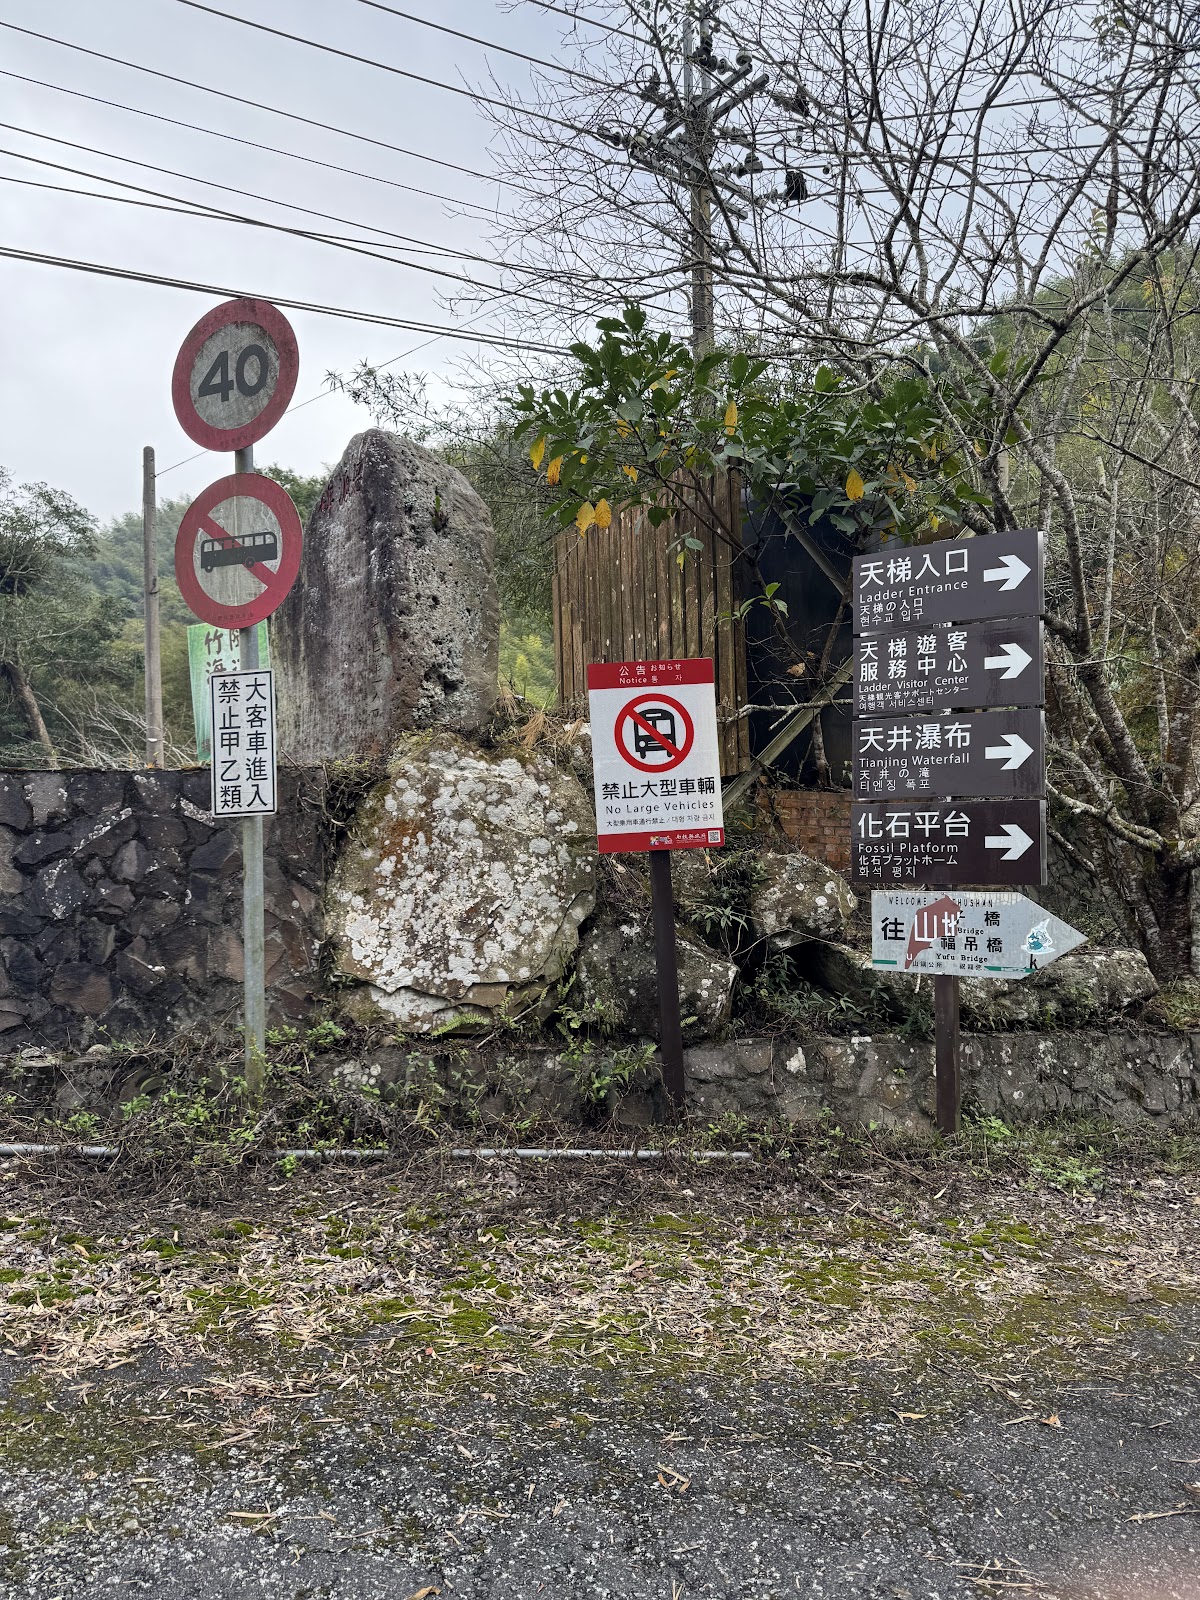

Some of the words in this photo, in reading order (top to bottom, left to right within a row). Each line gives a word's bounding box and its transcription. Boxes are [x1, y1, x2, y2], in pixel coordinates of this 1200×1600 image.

[198, 344, 269, 402] 40
[859, 548, 968, 589] 天梯入口
[859, 589, 903, 604] Ladder
[909, 580, 968, 596] Entrance
[860, 598, 923, 616] 天梯の入口
[860, 613, 894, 627] 현수교
[901, 609, 923, 622] 입구
[859, 631, 968, 661] 天梯遊客
[619, 665, 646, 676] 公告
[650, 663, 681, 672] お知らせ
[859, 653, 968, 682] 服務中心
[619, 677, 648, 685] Notice
[858, 683, 891, 693] Ladder
[897, 680, 928, 690] Visitor
[934, 676, 969, 686] Center
[218, 678, 242, 810] 禁止甲乙類
[245, 677, 268, 807] 大客車進入
[859, 722, 972, 753] 天井瀑布
[859, 757, 908, 769] Tianjing
[911, 753, 970, 765] Waterfall
[602, 776, 715, 800] 禁止大型車輛
[605, 806, 621, 814] No
[626, 804, 660, 814] Large
[664, 800, 714, 811] Vehicles
[857, 810, 971, 838] 化石平台
[858, 842, 894, 853] Fossil
[900, 842, 958, 853] Platform
[858, 854, 958, 866] 化石プラットホーム
[858, 866, 882, 878] 화석
[892, 866, 916, 878] 평지
[888, 896, 927, 906] WELCOME
[953, 898, 993, 907] HUSHAN
[881, 916, 906, 941] 往
[957, 927, 984, 935] Bridge
[928, 935, 1003, 953] 福吊橋
[961, 954, 988, 963] Bridge
